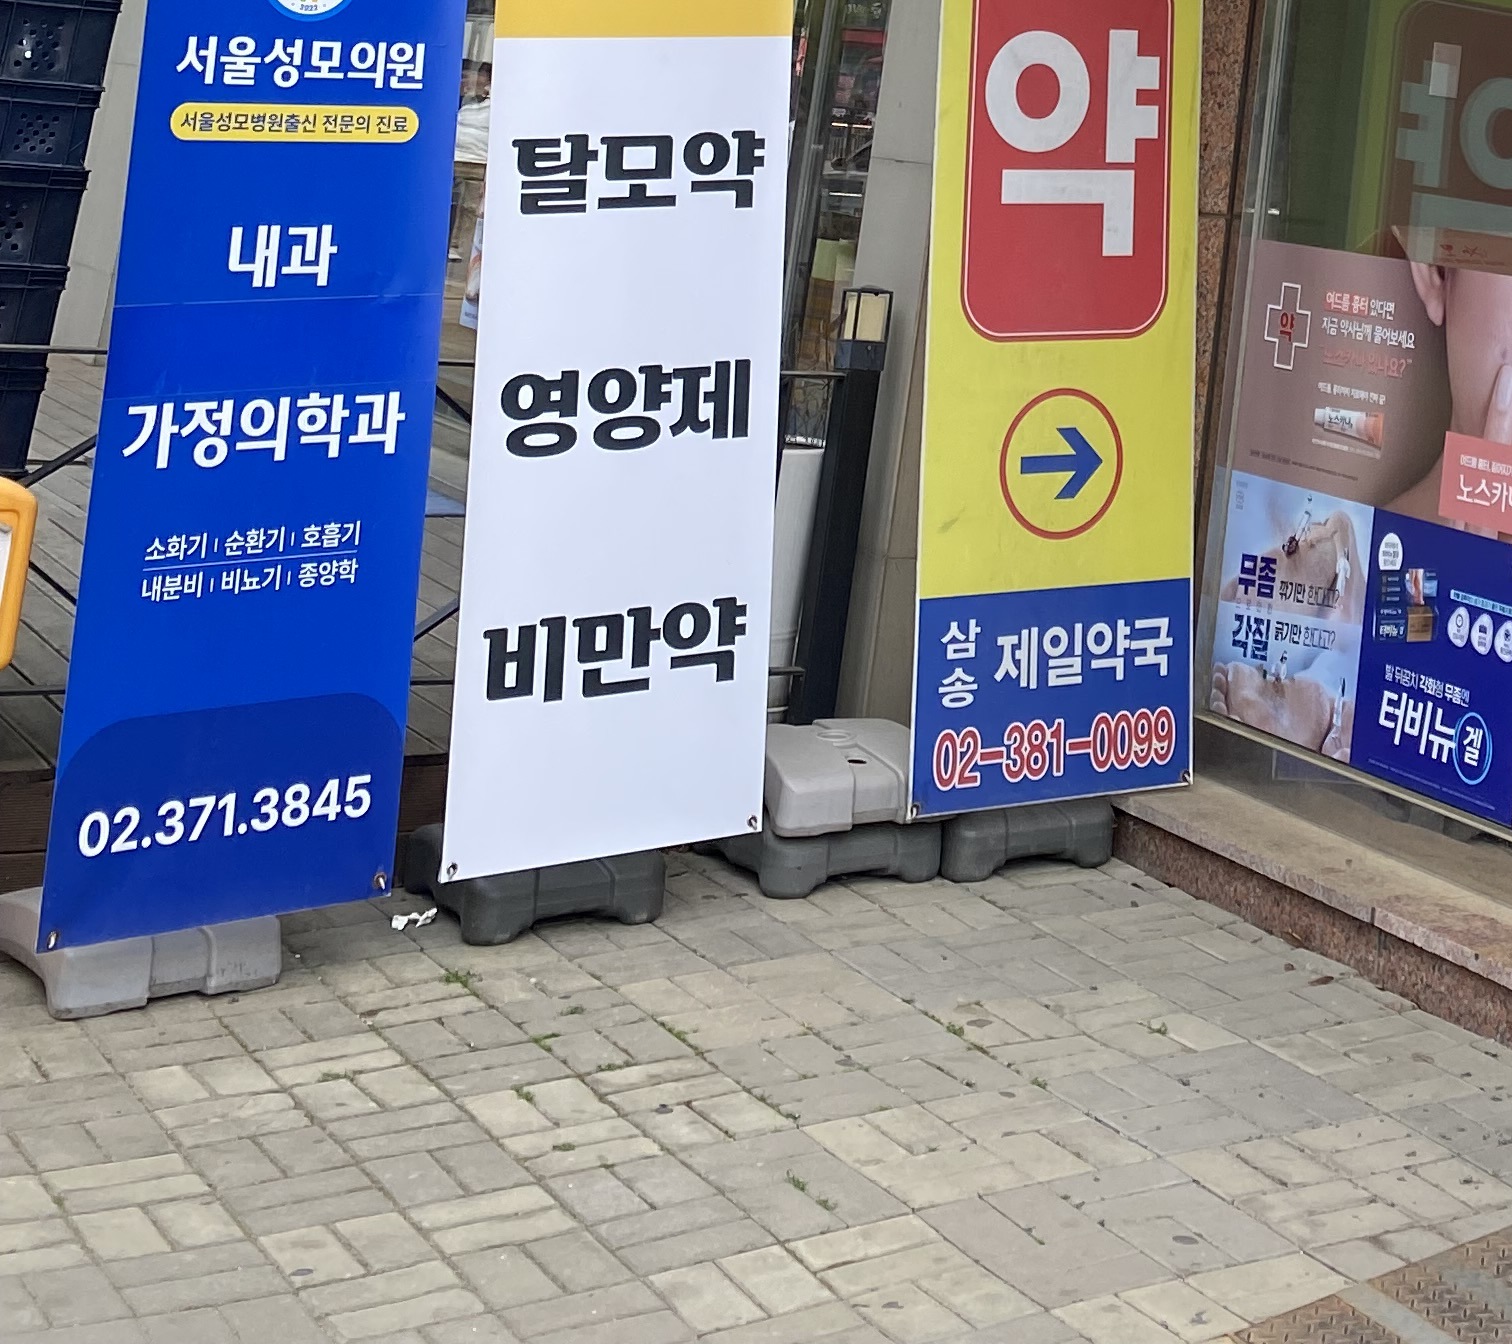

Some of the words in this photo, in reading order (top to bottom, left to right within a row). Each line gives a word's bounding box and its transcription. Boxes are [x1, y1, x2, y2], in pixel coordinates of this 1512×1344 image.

[175, 33, 428, 91] 서울성모의원
[180, 110, 317, 135] 서울성모병원출신
[322, 114, 371, 135] 전문의
[376, 115, 408, 135] 진료
[985, 28, 1161, 257] 약
[511, 129, 767, 216] 탈모약
[227, 223, 338, 288] 내과
[1279, 310, 1296, 343] 약
[1321, 316, 1339, 336] 지금
[1339, 320, 1373, 342] 약사님께
[1373, 325, 1416, 350] 물어보세요
[1325, 290, 1351, 312] 여드름
[1369, 299, 1396, 321] 있다면
[121, 389, 406, 470] 가정의학과
[500, 357, 753, 459] 영양제
[144, 532, 209, 562] 소화기
[224, 525, 286, 557] 순환기
[301, 519, 362, 550] 호흡기
[141, 570, 203, 603] 내분비
[220, 563, 282, 596] 비뇨기
[297, 558, 360, 590] 종양학
[1238, 552, 1278, 600] 무좀
[482, 595, 749, 703] 비만약
[938, 617, 982, 709] 삼송
[993, 616, 1174, 691] 제일약국
[1231, 613, 1272, 662] 각질
[1303, 624, 1336, 652] 한다고?
[1385, 663, 1395, 683] 발
[1394, 666, 1419, 690] 뒤꿈치
[1444, 683, 1471, 709] 무좀엔
[932, 705, 1177, 792] 02-381-0099
[1378, 689, 1457, 765] 터비뉴
[1463, 723, 1483, 768] 겔
[77, 773, 374, 859] 02.371.3845
